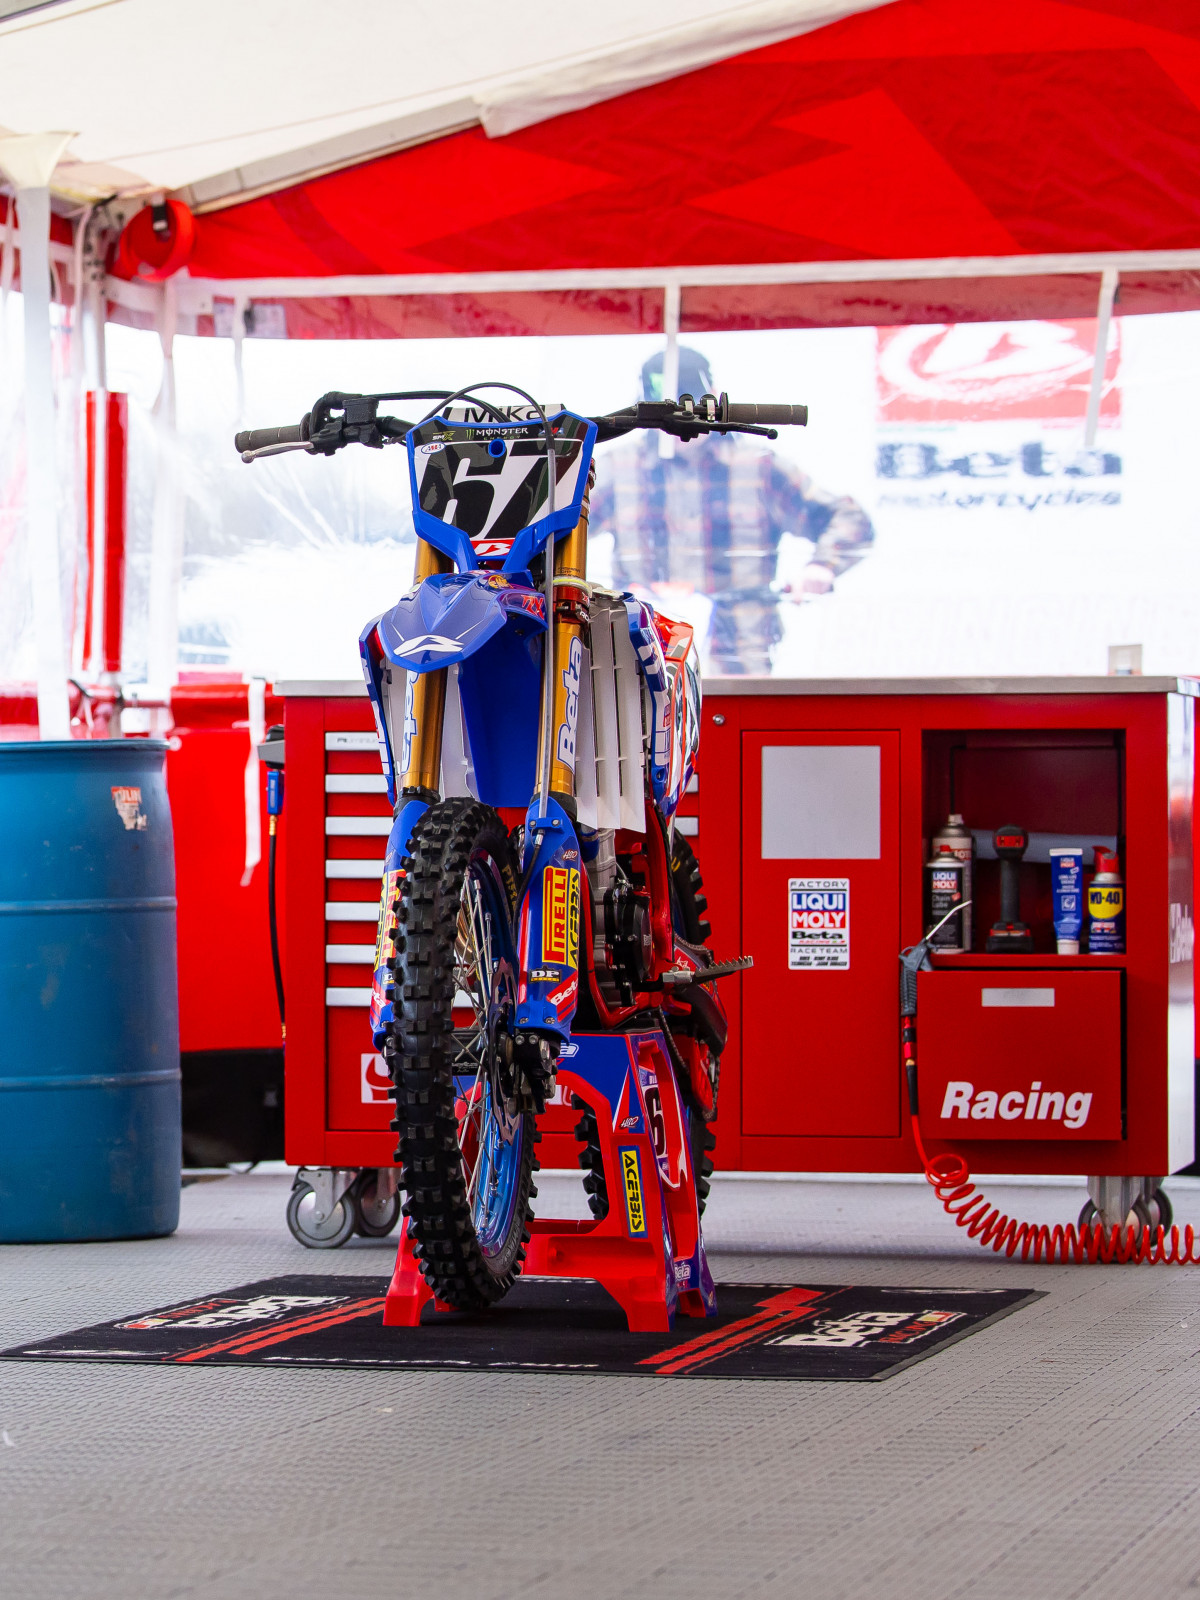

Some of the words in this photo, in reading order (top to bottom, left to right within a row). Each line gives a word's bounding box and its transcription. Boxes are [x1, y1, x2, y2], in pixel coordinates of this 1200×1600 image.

[476, 428, 529, 437] MONSTER
[876, 441, 1123, 480] Beta
[418, 440, 582, 539] 67
[557, 635, 583, 775] Beta
[932, 872, 957, 881] LIQUI
[932, 880, 957, 889] MOLY
[792, 893, 844, 911] LIQUI
[1090, 891, 1120, 905] WD-40
[544, 866, 567, 963] PIRELLI
[792, 912, 845, 928] MOLY
[792, 931, 843, 940] Beta
[531, 970, 560, 978] DP
[940, 1081, 1093, 1130] Racing
[764, 1311, 918, 1348] Beta
